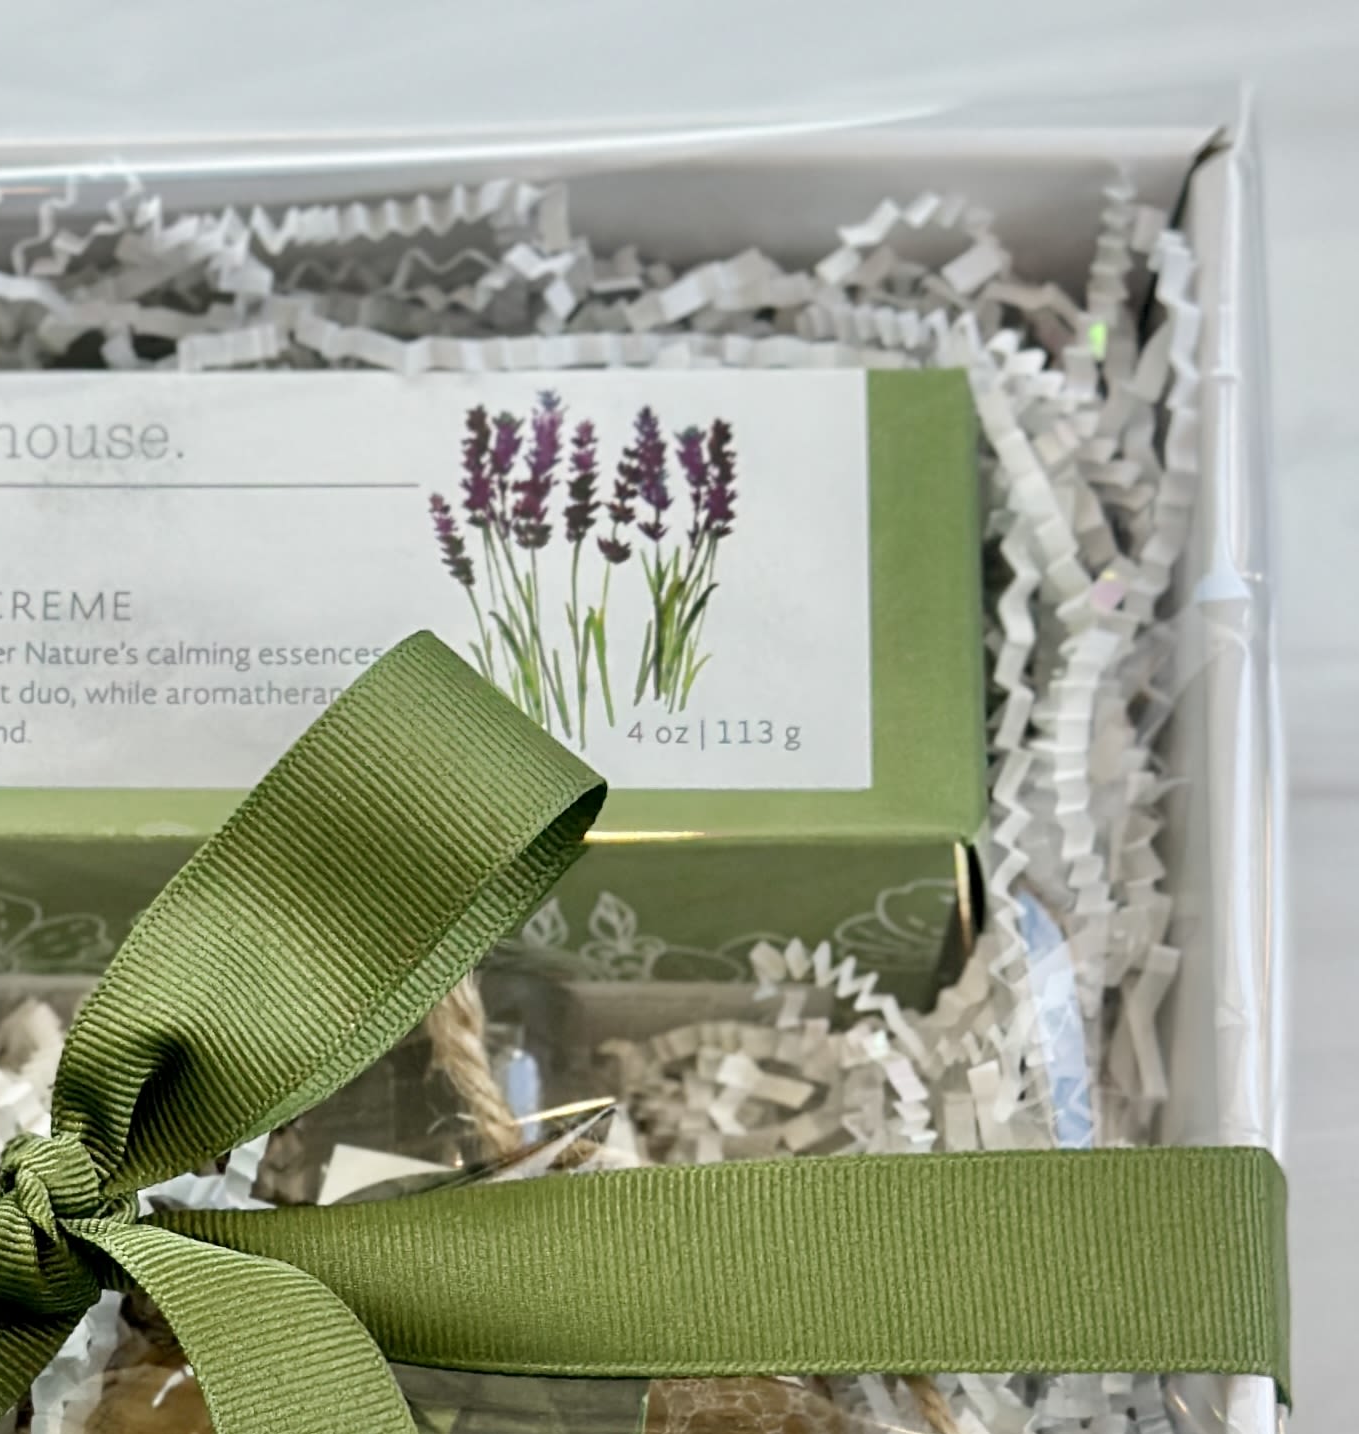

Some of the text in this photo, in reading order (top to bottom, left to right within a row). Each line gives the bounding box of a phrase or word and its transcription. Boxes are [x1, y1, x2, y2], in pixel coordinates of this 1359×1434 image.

[25, 641, 139, 665] Nature's
[146, 641, 250, 672] calming
[19, 682, 76, 708] duo,
[85, 682, 157, 704] while
[627, 721, 644, 744] 4
[656, 726, 689, 745] oz
[717, 721, 774, 744] 113
[785, 726, 802, 751] g
